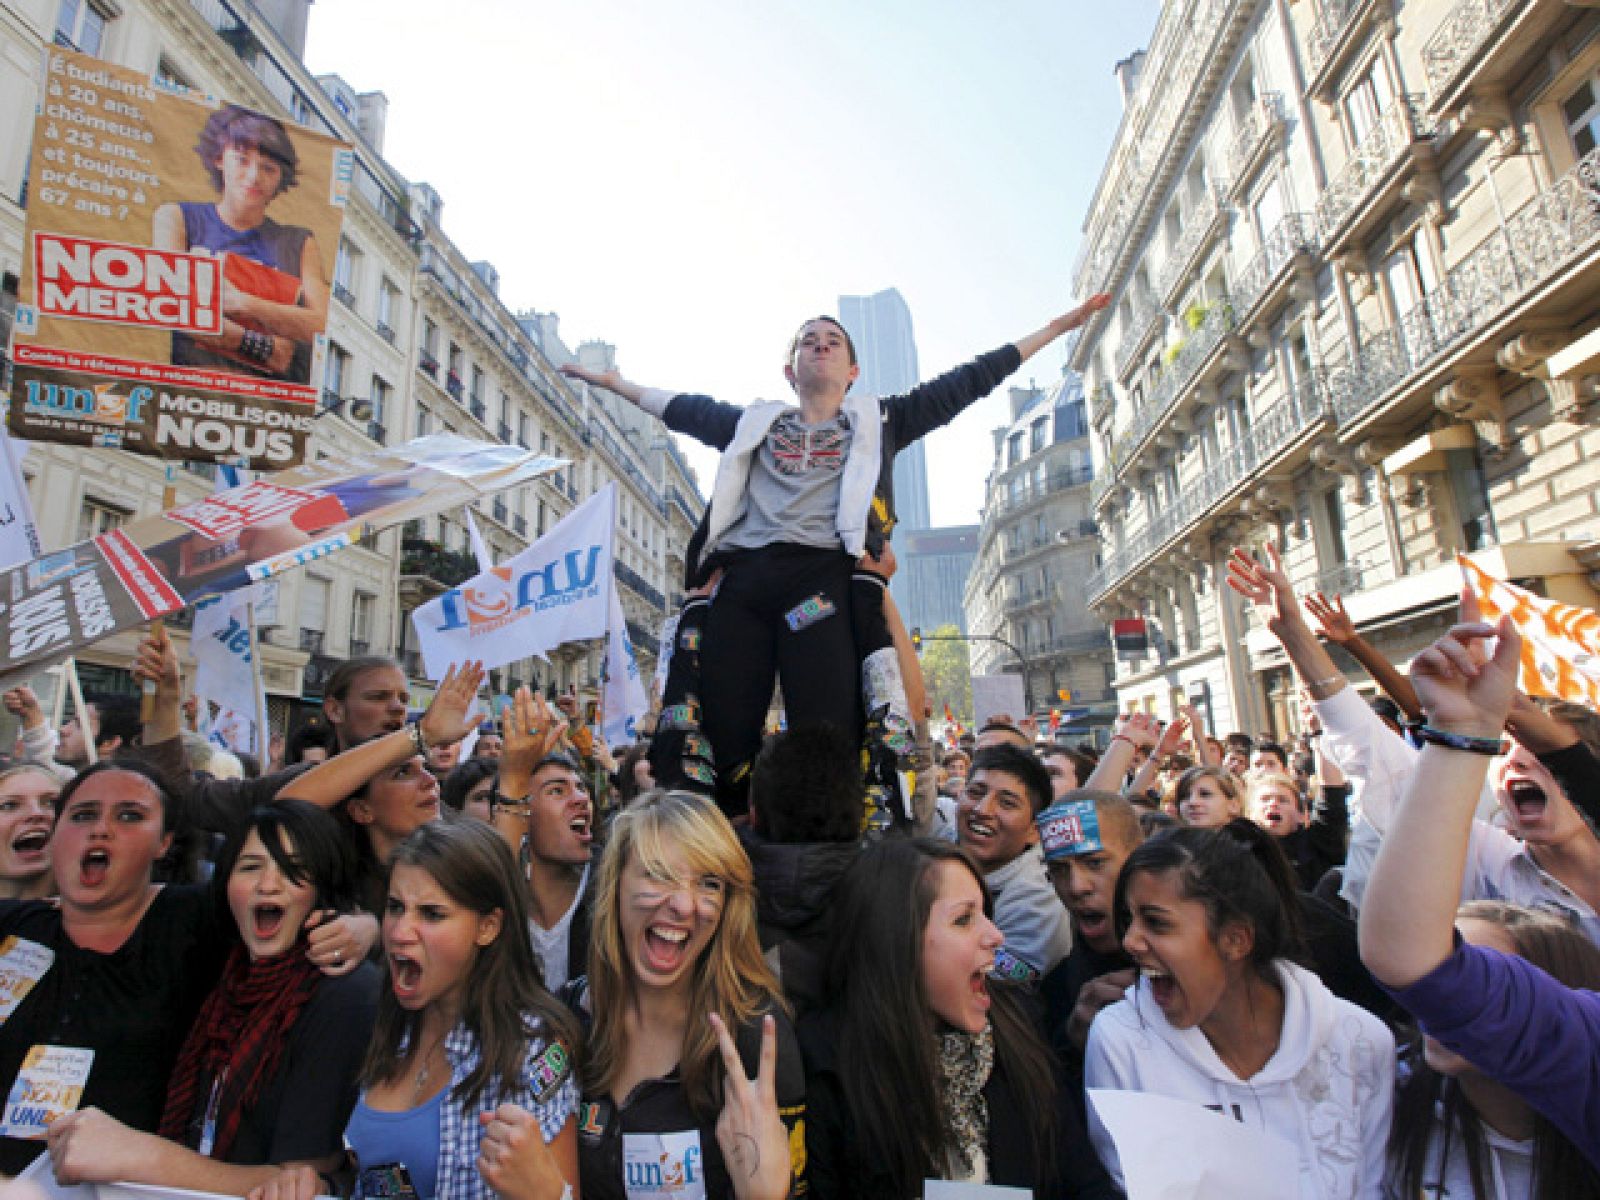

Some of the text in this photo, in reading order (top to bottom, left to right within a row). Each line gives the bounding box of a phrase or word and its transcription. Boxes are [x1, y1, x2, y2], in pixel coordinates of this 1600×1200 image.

[49, 77, 63, 96] à
[69, 84, 97, 105] 20
[44, 120, 59, 139] à
[64, 128, 96, 149] 25
[73, 152, 160, 188] toujours
[40, 187, 69, 205] 67
[44, 282, 190, 326] MERCI
[156, 415, 294, 462] NOUS
